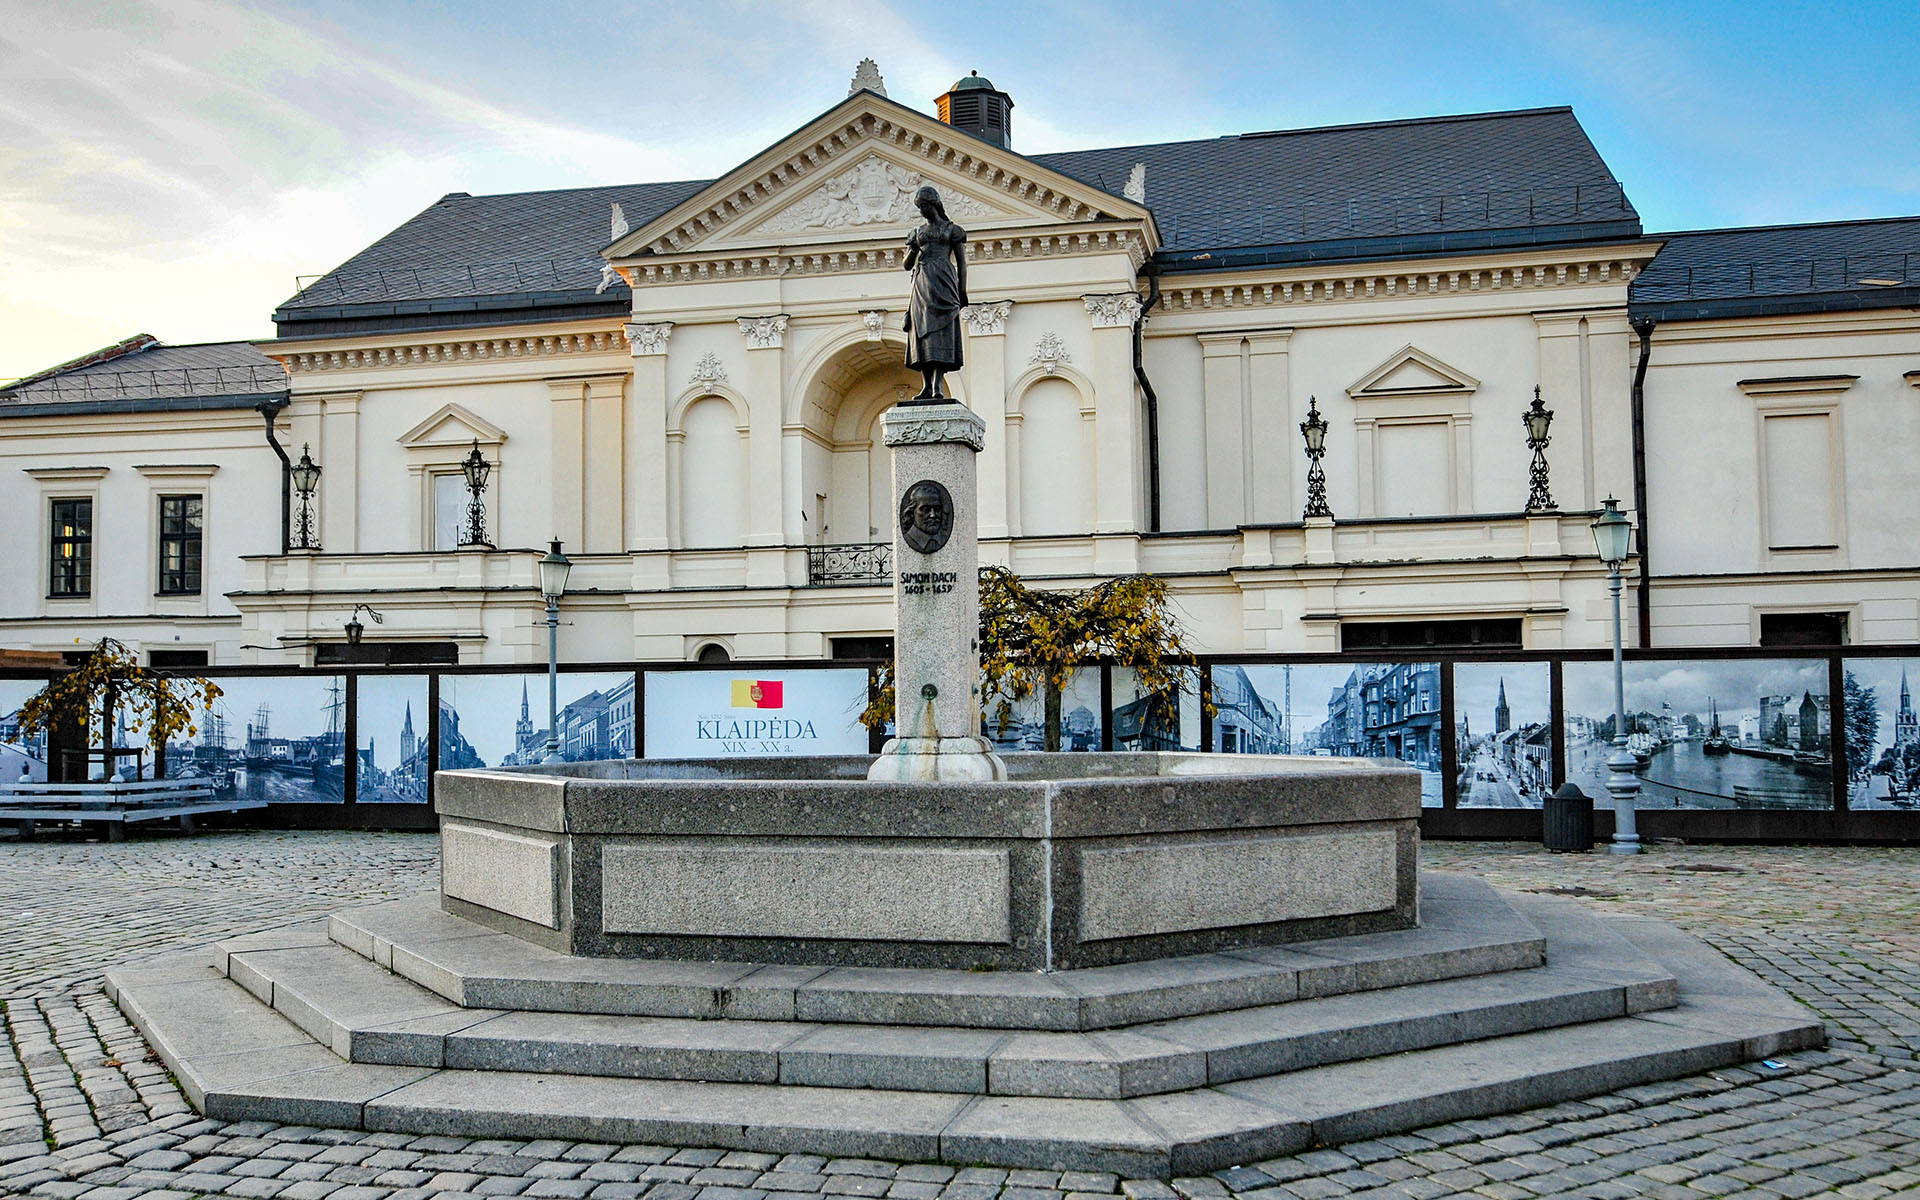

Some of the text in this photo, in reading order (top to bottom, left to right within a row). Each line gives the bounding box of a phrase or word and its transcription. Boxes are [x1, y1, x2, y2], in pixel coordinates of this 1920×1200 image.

[900, 572, 957, 584] SIMON DACH
[904, 584, 925, 594] 1605
[932, 584, 953, 594] 1659
[696, 716, 818, 739] KLAIPĖDA
[722, 741, 747, 753] XIX
[760, 741, 781, 753] XX
[784, 744, 794, 753] a.
